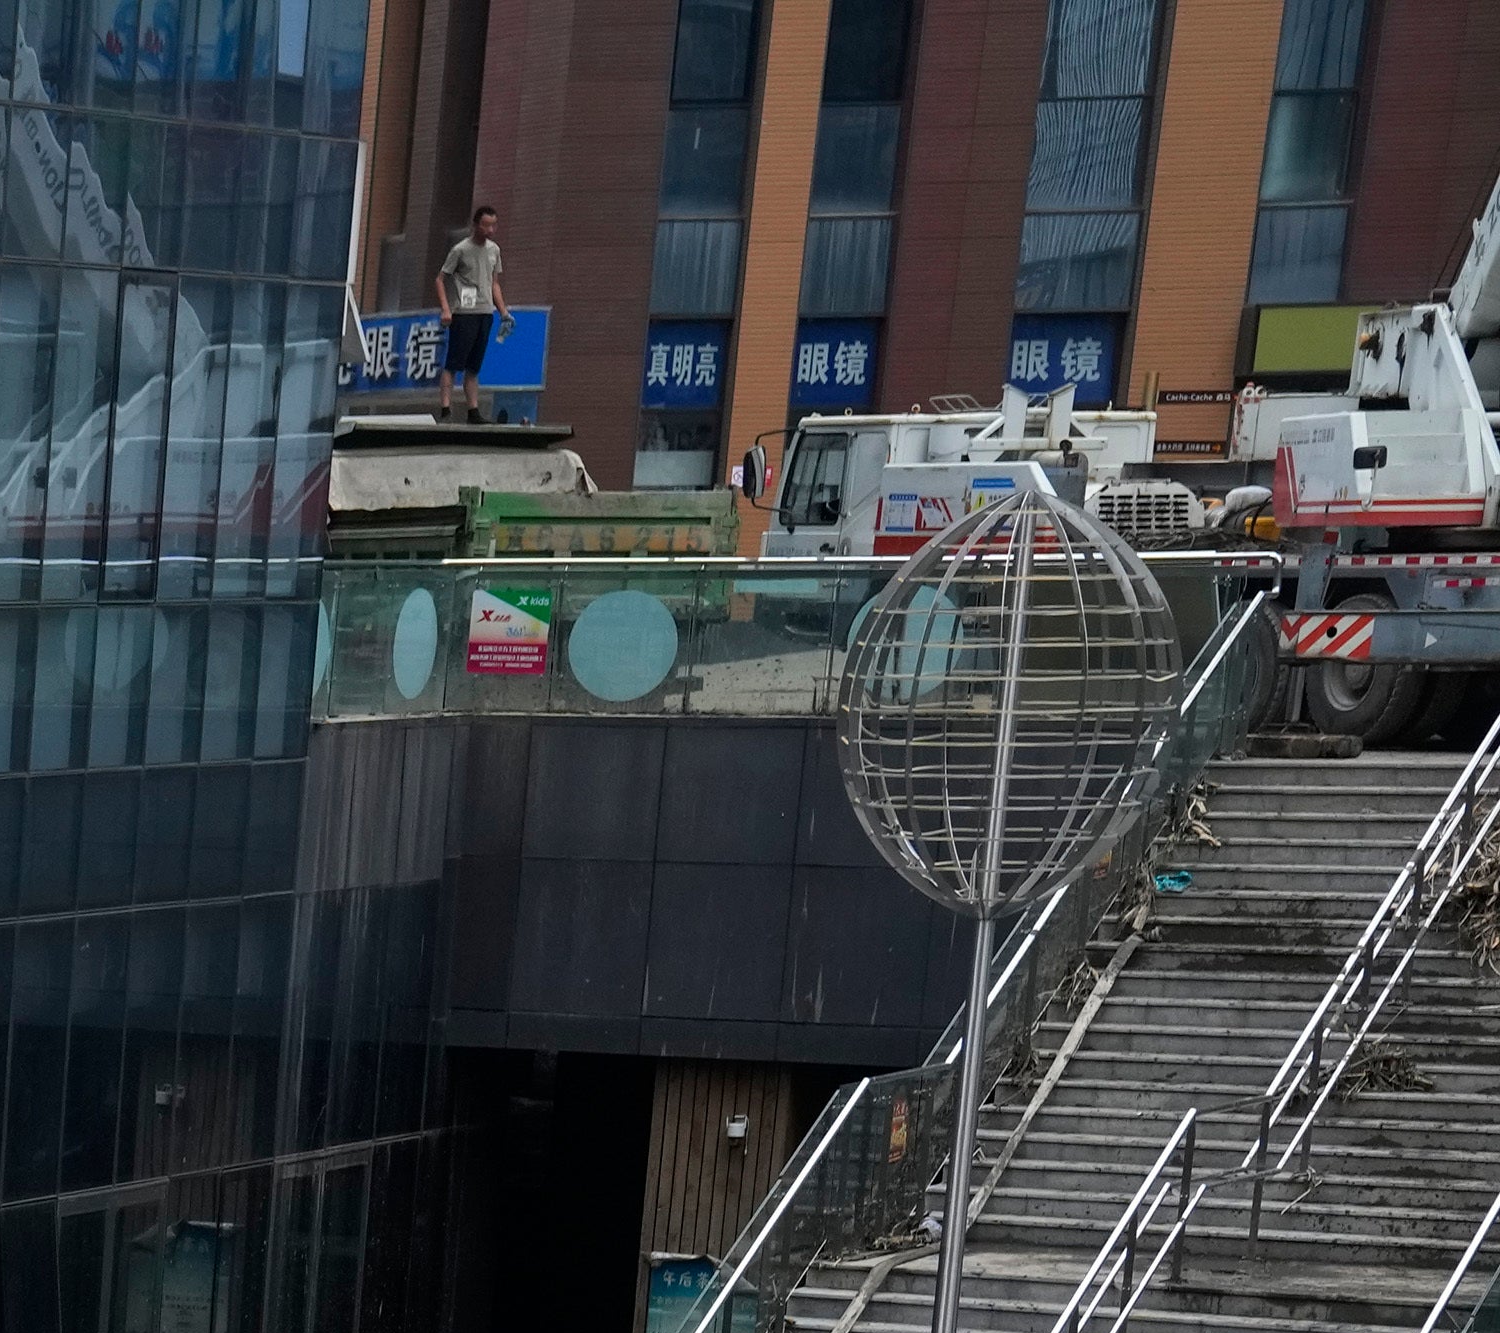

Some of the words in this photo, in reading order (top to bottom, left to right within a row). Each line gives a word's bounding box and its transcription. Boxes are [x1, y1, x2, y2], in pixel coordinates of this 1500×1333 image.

[647, 343, 718, 386] 真明亮
[798, 342, 868, 386] 眼镜
[1010, 338, 1102, 382] 眼镜
